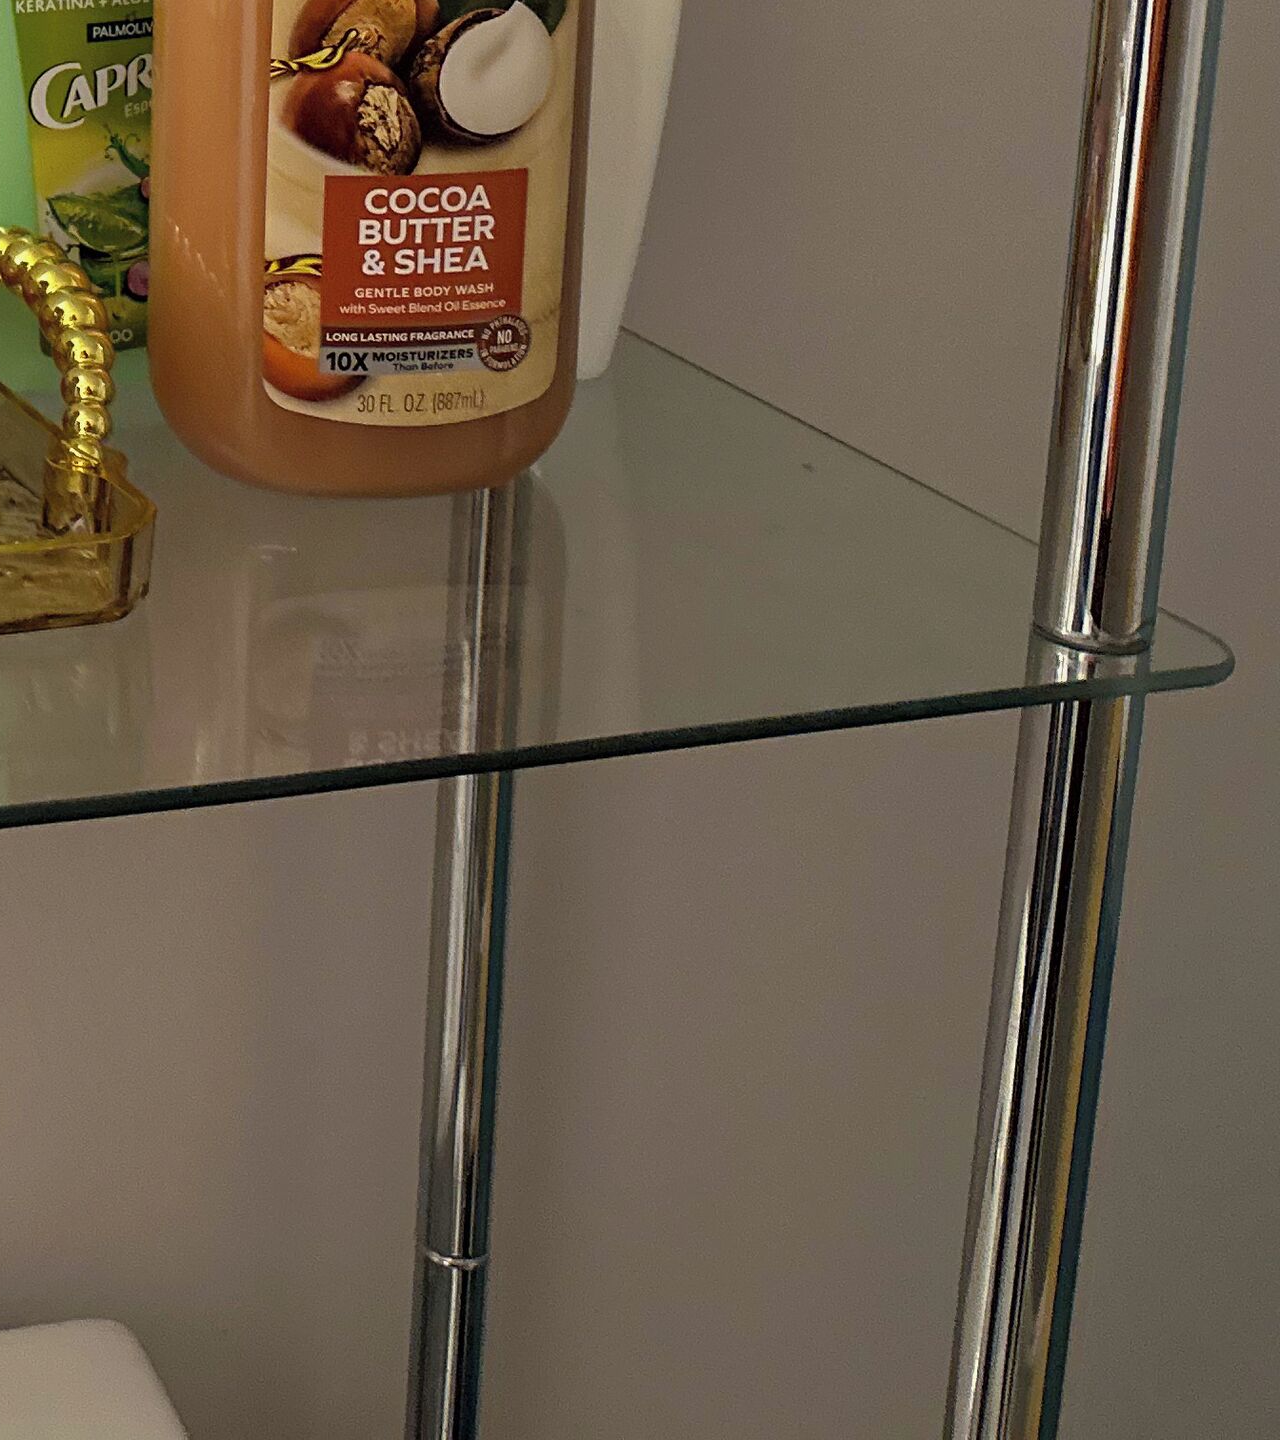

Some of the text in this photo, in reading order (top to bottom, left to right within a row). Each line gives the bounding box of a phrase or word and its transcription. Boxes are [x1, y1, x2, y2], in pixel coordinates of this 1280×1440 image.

[364, 184, 492, 215] COCOA
[358, 215, 495, 246] BUTTER
[362, 246, 489, 276] & SHEA
[354, 282, 494, 299] GENTLE BODY WASH
[339, 298, 507, 315] with Sweet Blend Oil Essence
[326, 329, 475, 342] LONG LASTING FRAGRANCE
[497, 329, 513, 344] NO
[325, 348, 474, 372] 10X MOISTURIZERS
[393, 361, 454, 371] Than Before
[357, 394, 375, 413] 30
